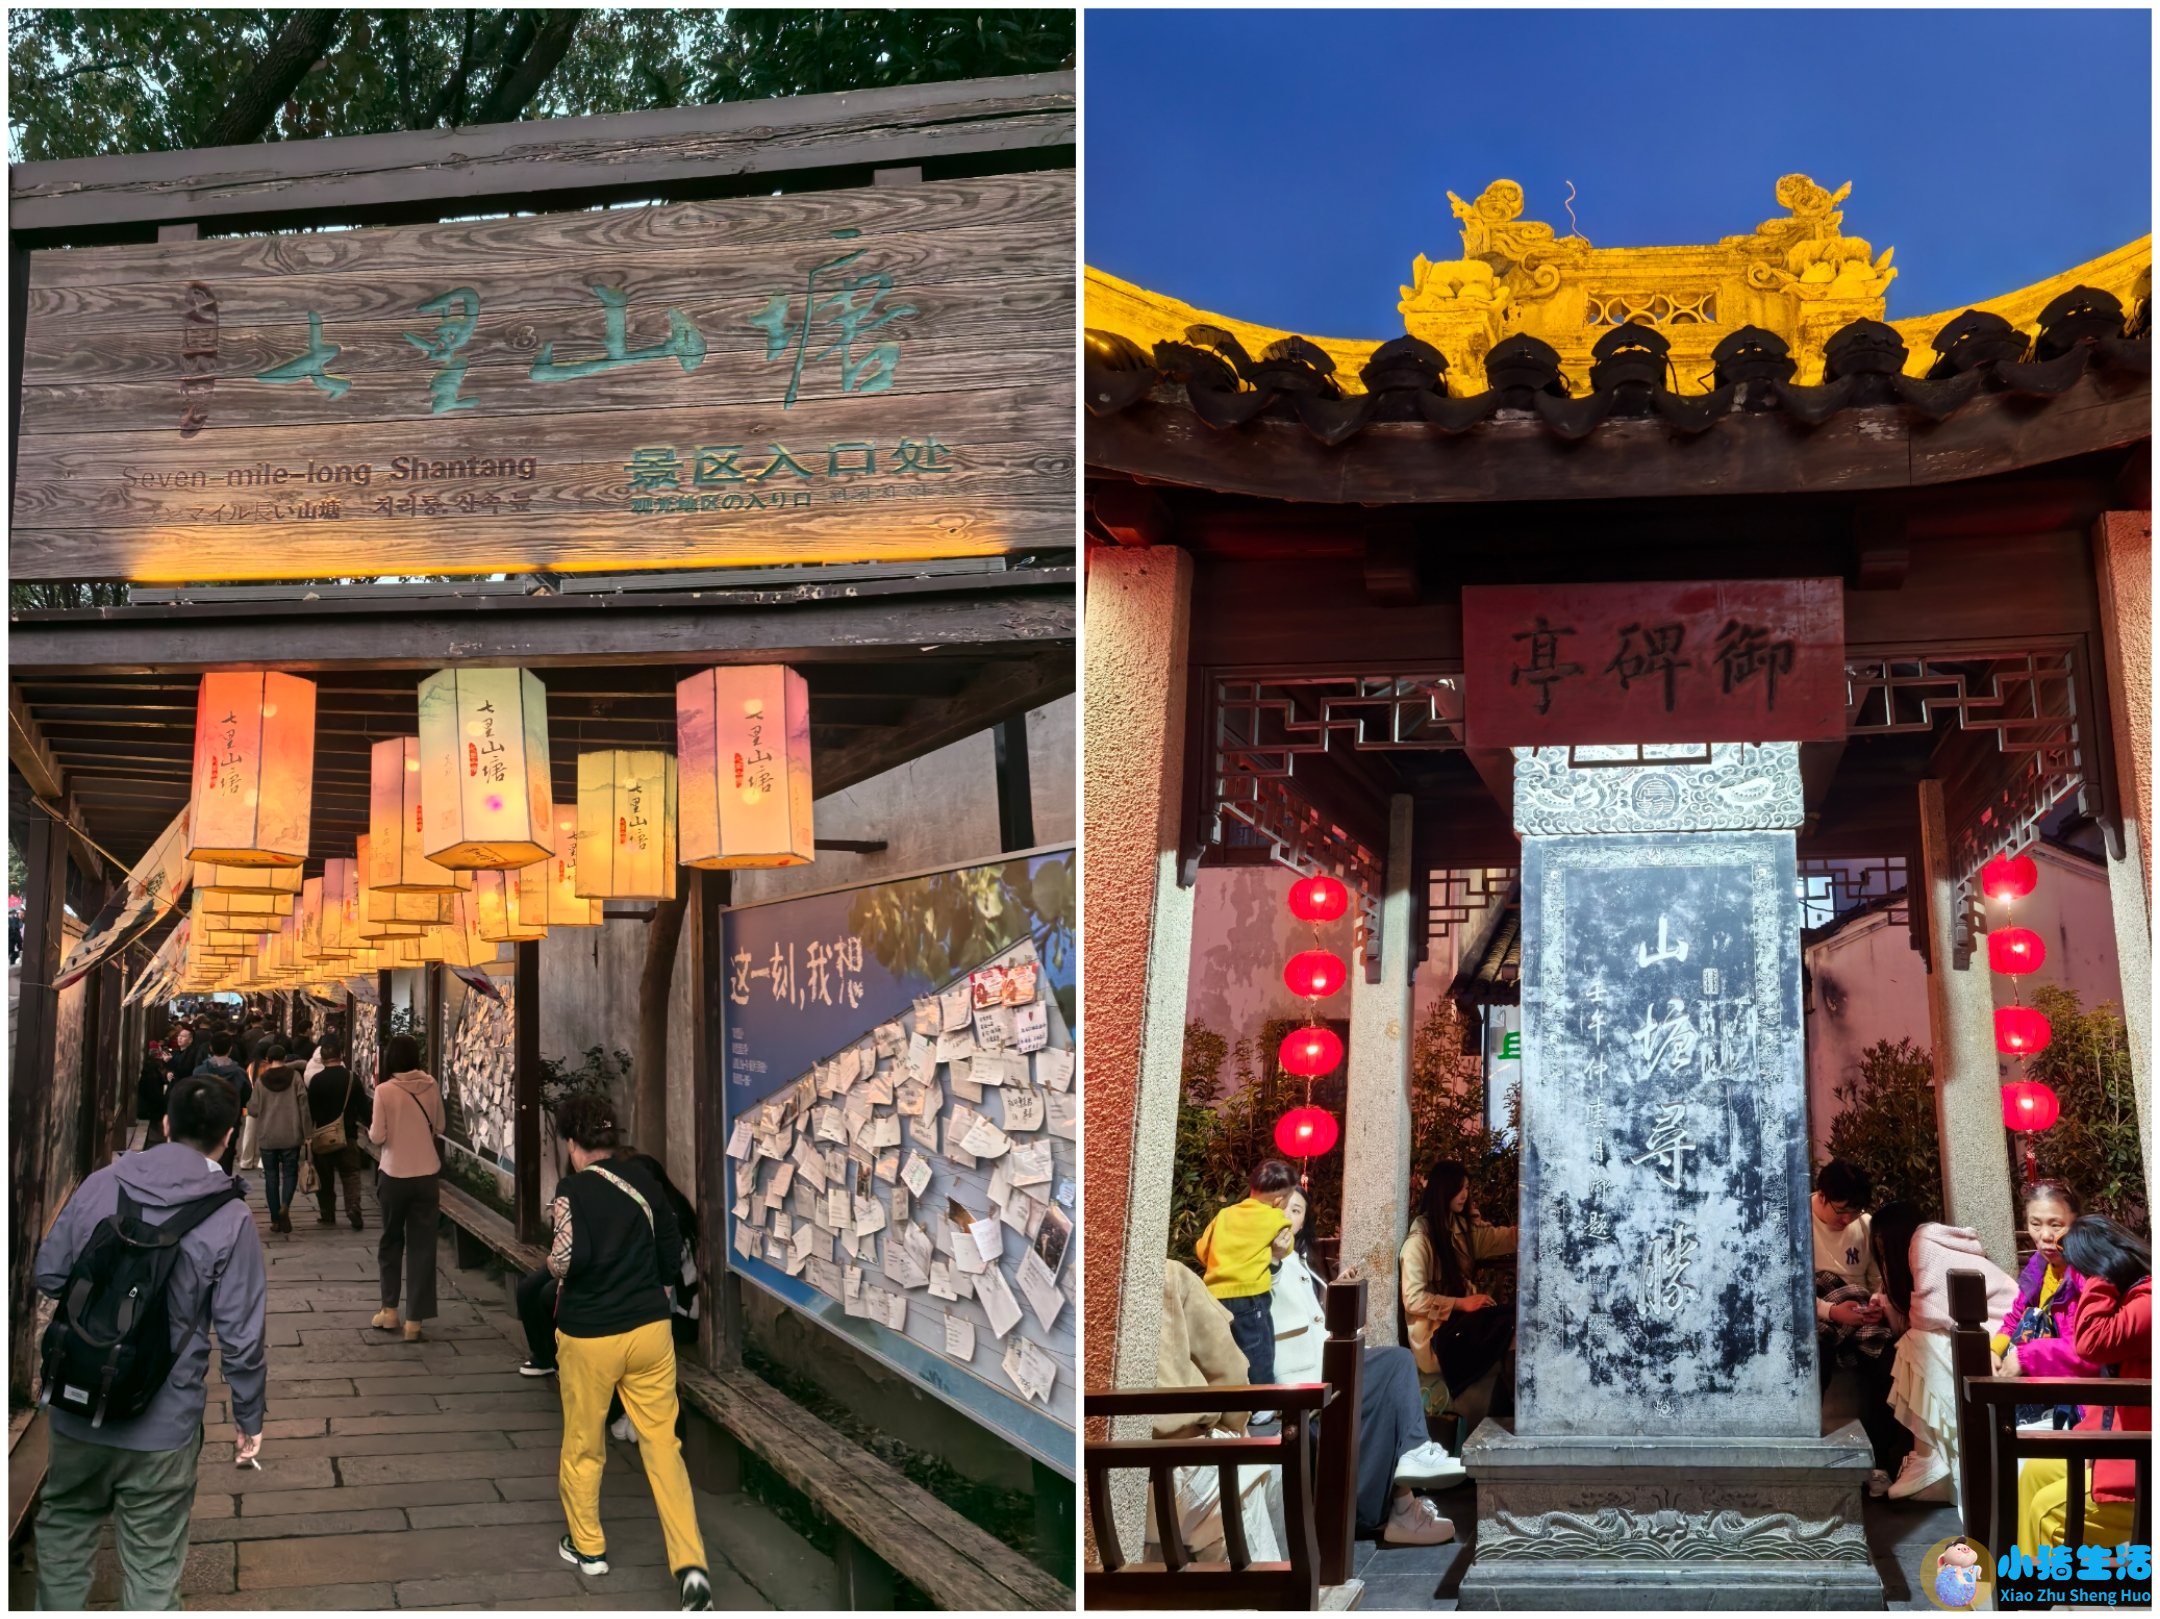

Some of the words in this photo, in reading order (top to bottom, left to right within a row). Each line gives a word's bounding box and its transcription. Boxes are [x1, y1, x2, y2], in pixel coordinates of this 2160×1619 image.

[255, 228, 918, 414] 七里山塘
[122, 460, 372, 488] Seven-mile-long
[391, 456, 537, 481] Shantang
[623, 435, 953, 488] 景区入口处
[1510, 613, 1795, 715] 御碑亭
[221, 710, 242, 796] 七里山塘
[477, 700, 507, 783] 七里山塘
[745, 710, 774, 794] 七里山塘
[1845, 1246, 1860, 1265] NY
